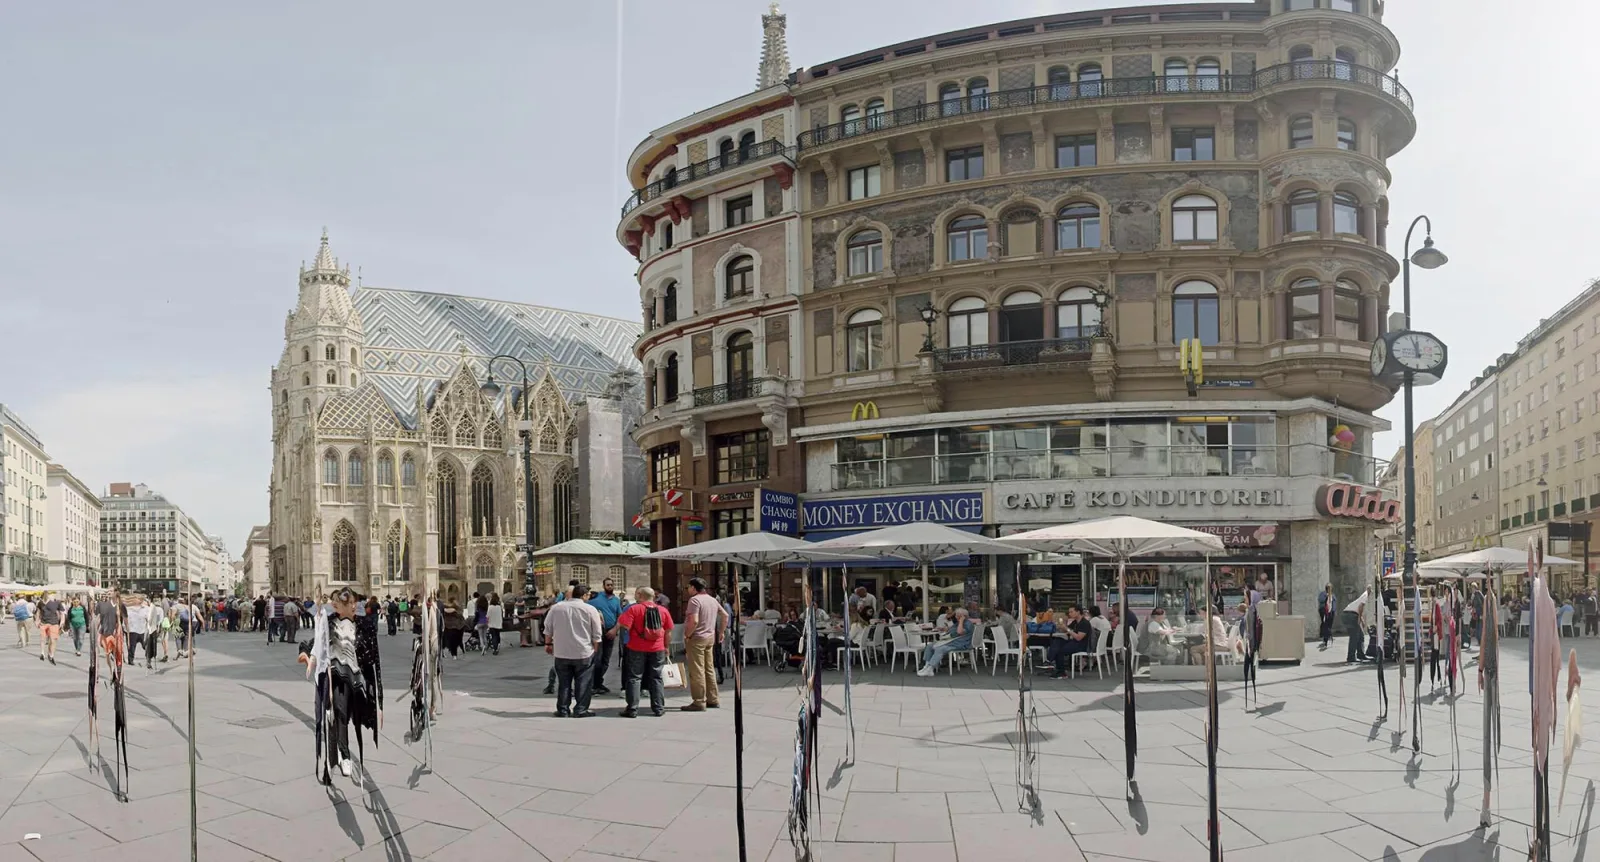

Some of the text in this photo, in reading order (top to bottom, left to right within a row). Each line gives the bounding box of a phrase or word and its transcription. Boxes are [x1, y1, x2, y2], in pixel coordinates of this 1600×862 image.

[765, 492, 794, 505] CAMBIO
[1003, 489, 1284, 509] CAFÉ KONDITOREI
[761, 505, 798, 520] CHANGE
[803, 498, 983, 528] MONEY EXCHANGE
[1224, 535, 1250, 544] EAM
